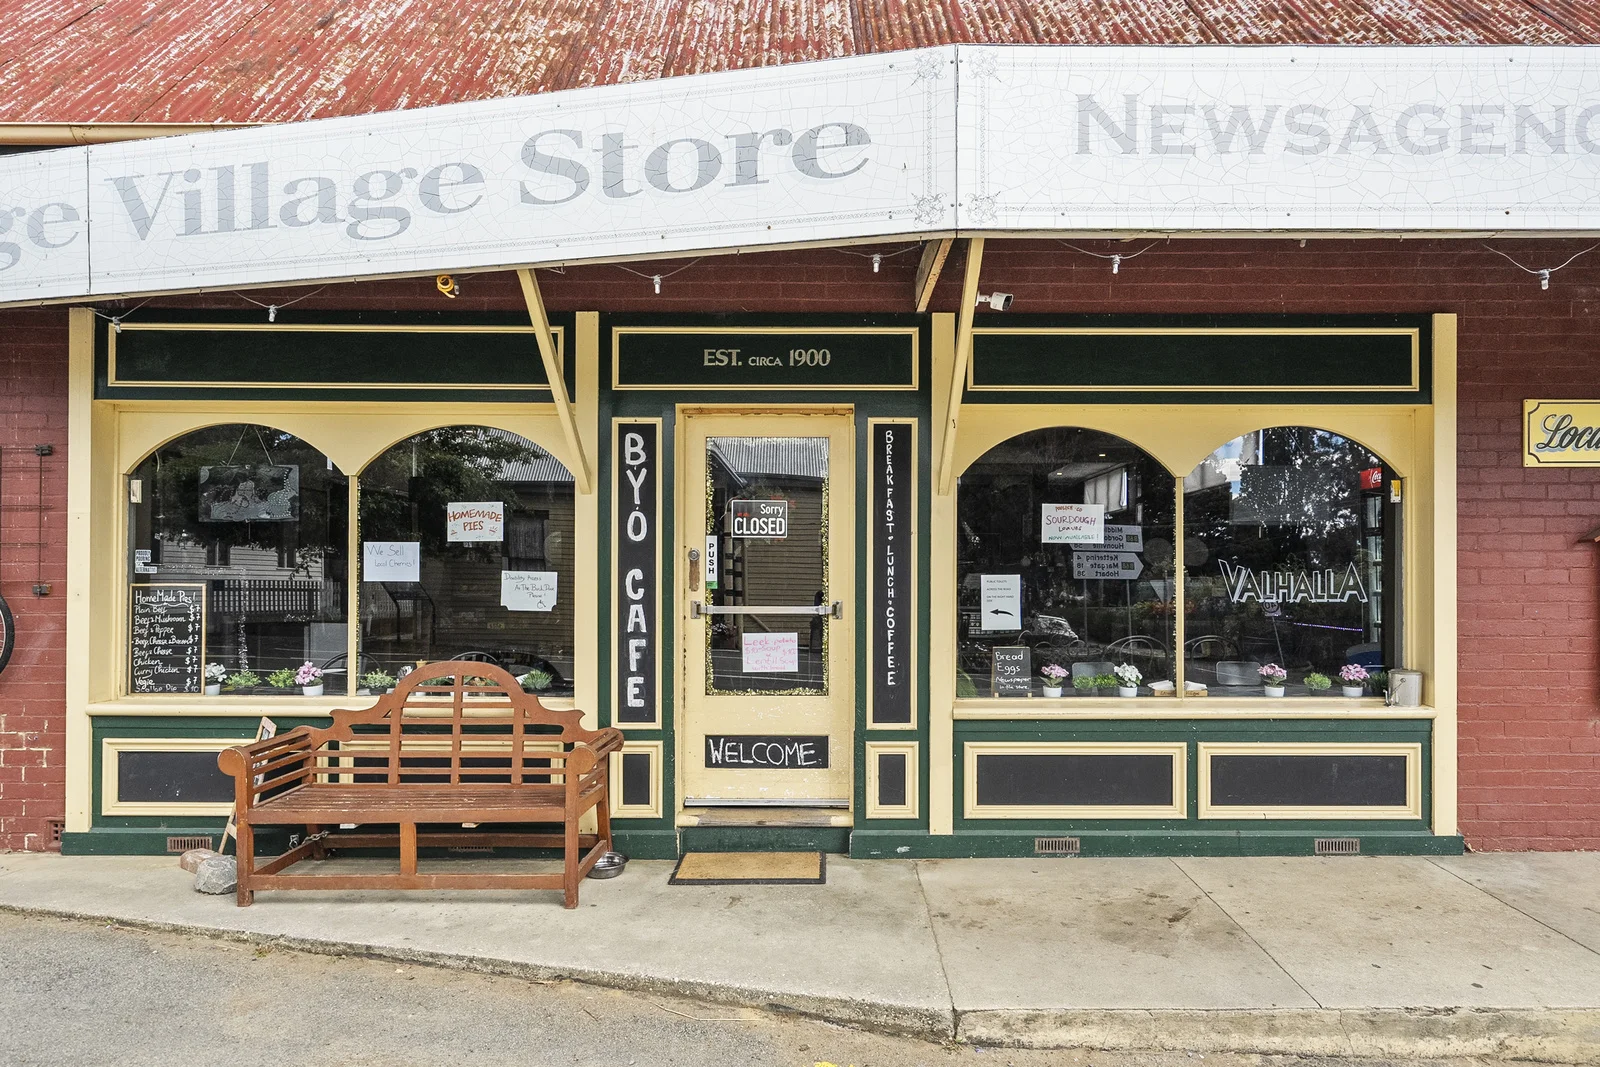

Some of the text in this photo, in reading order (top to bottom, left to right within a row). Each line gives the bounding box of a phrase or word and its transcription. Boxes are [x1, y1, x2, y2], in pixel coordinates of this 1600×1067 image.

[104, 161, 485, 241] Village
[519, 122, 871, 205] Store
[703, 349, 831, 366] EST. CIRCA 1900
[448, 509, 502, 522] HOMEMADE
[760, 503, 784, 517] Sorry
[463, 521, 484, 531] PIES
[734, 517, 785, 535] CLOSED
[1046, 514, 1097, 526] SOURDOUGH
[366, 544, 404, 556] We Sell
[885, 430, 896, 687] BREAKFAST LUNCH COFFEE
[1218, 559, 1368, 603] VALHALLA
[625, 568, 647, 708] CAFE
[133, 657, 163, 667] Chicken
[995, 650, 1024, 661] Bread
[996, 661, 1021, 675] Eggs
[709, 738, 818, 766] WELCOME
